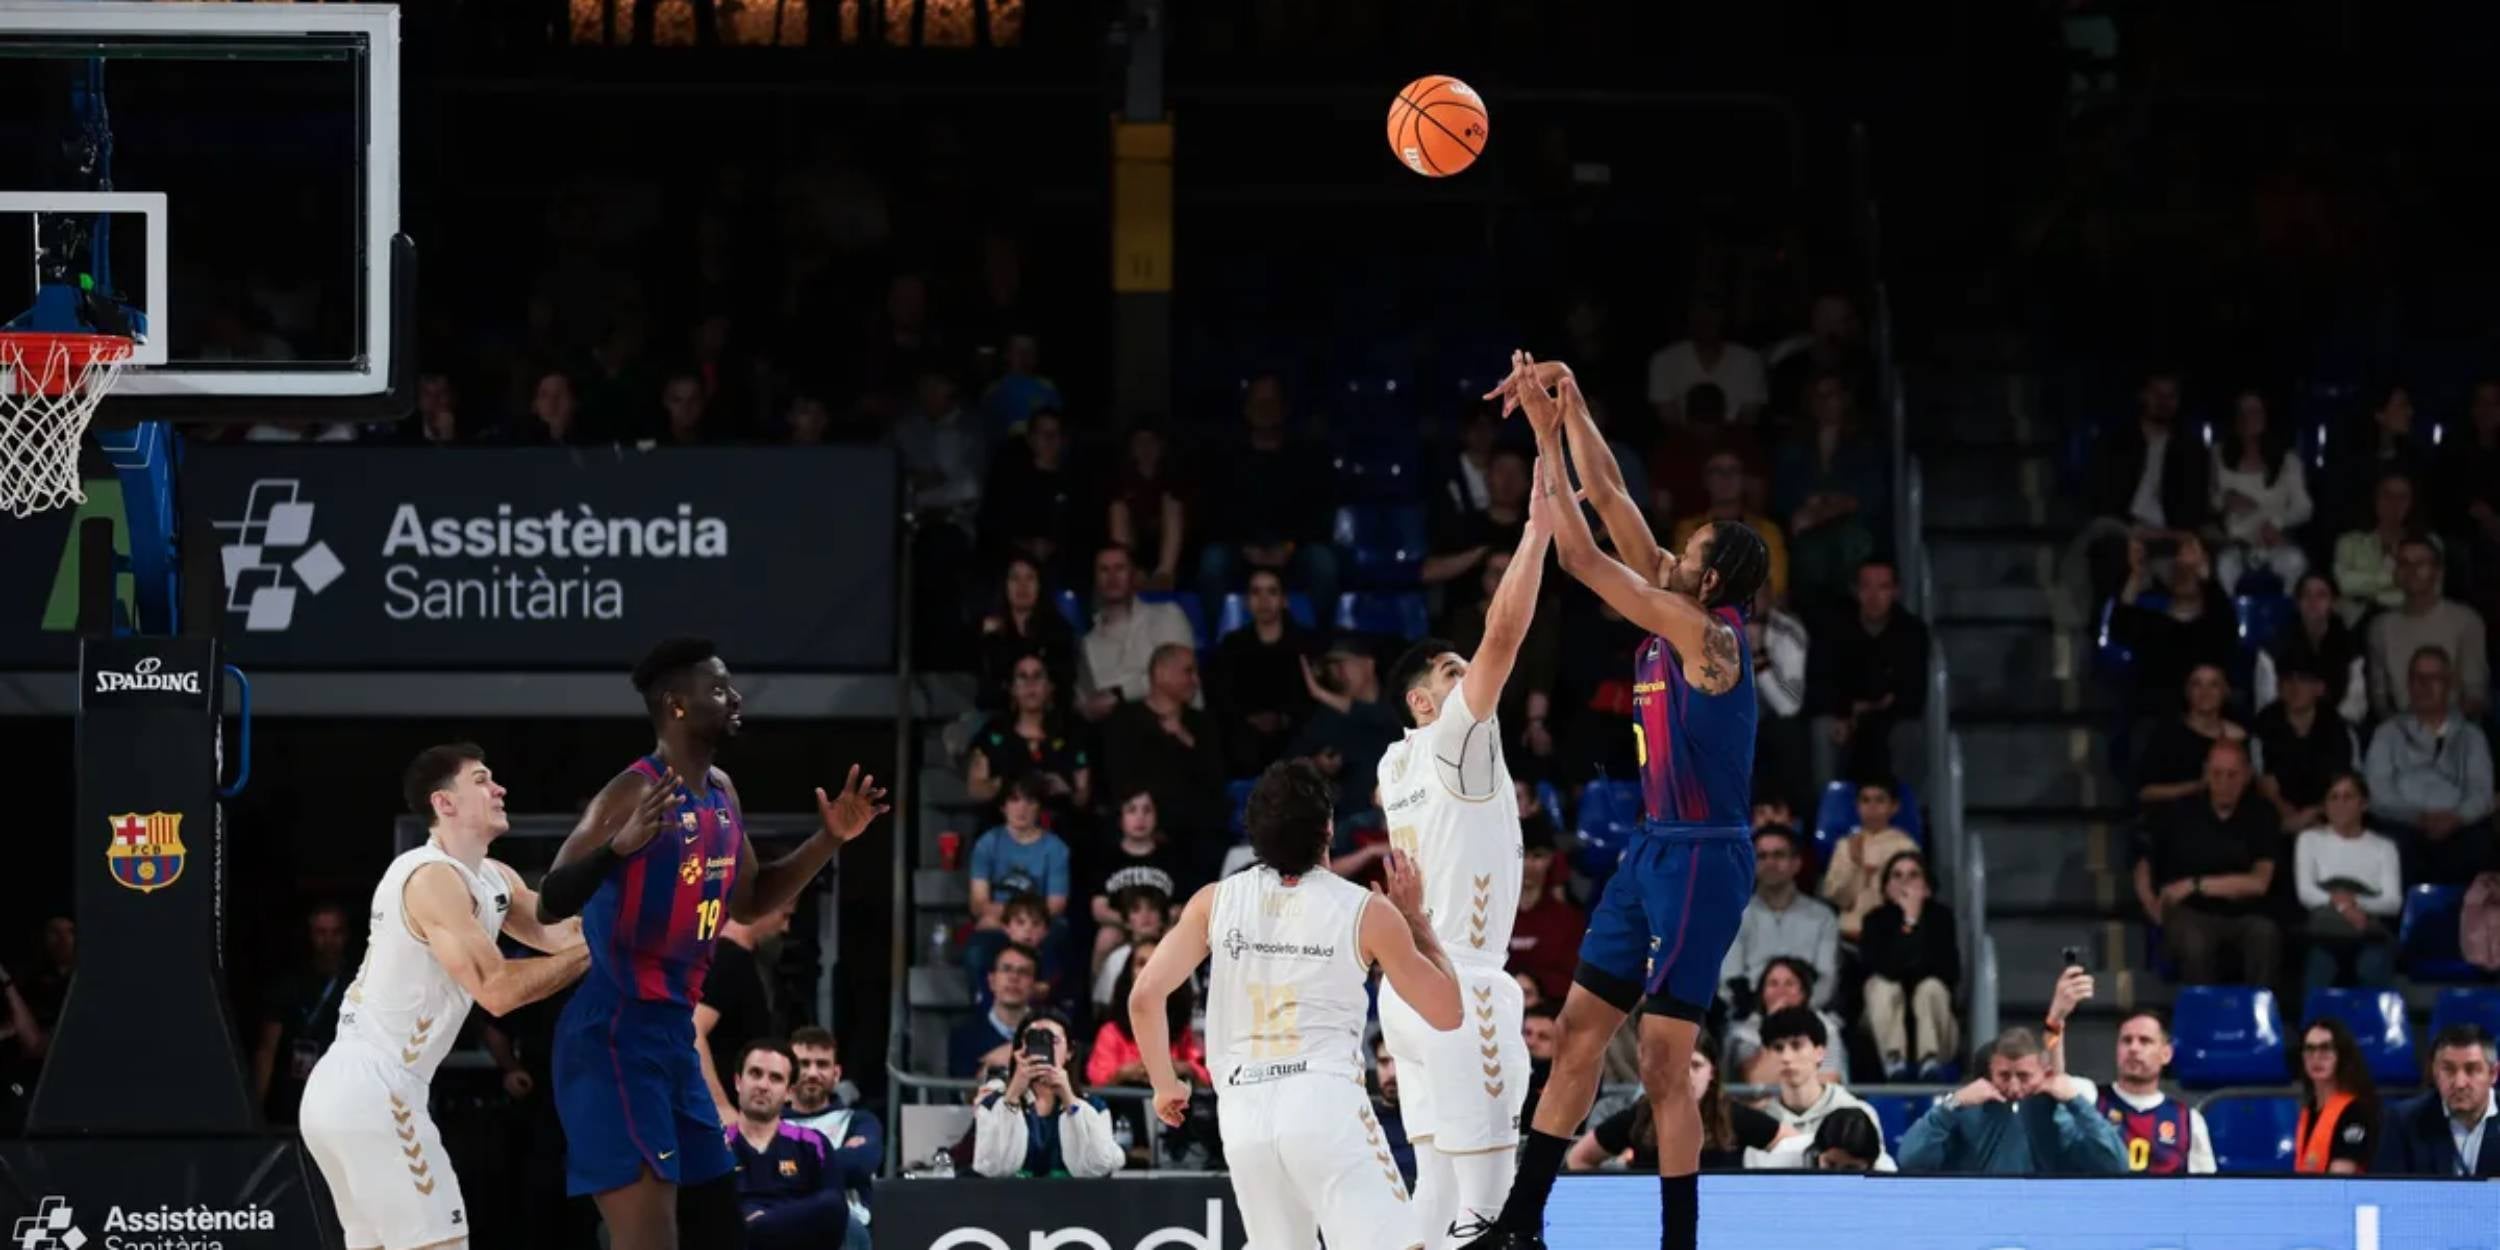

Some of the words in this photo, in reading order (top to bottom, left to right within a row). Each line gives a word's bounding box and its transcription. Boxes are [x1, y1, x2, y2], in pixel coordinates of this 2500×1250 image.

[383, 503, 728, 557] Assistència
[384, 565, 624, 619] Sanitària
[95, 668, 202, 694] SPALDING
[696, 899, 722, 942] 19
[1302, 943, 1335, 958] salud
[103, 1203, 275, 1232] Assistència
